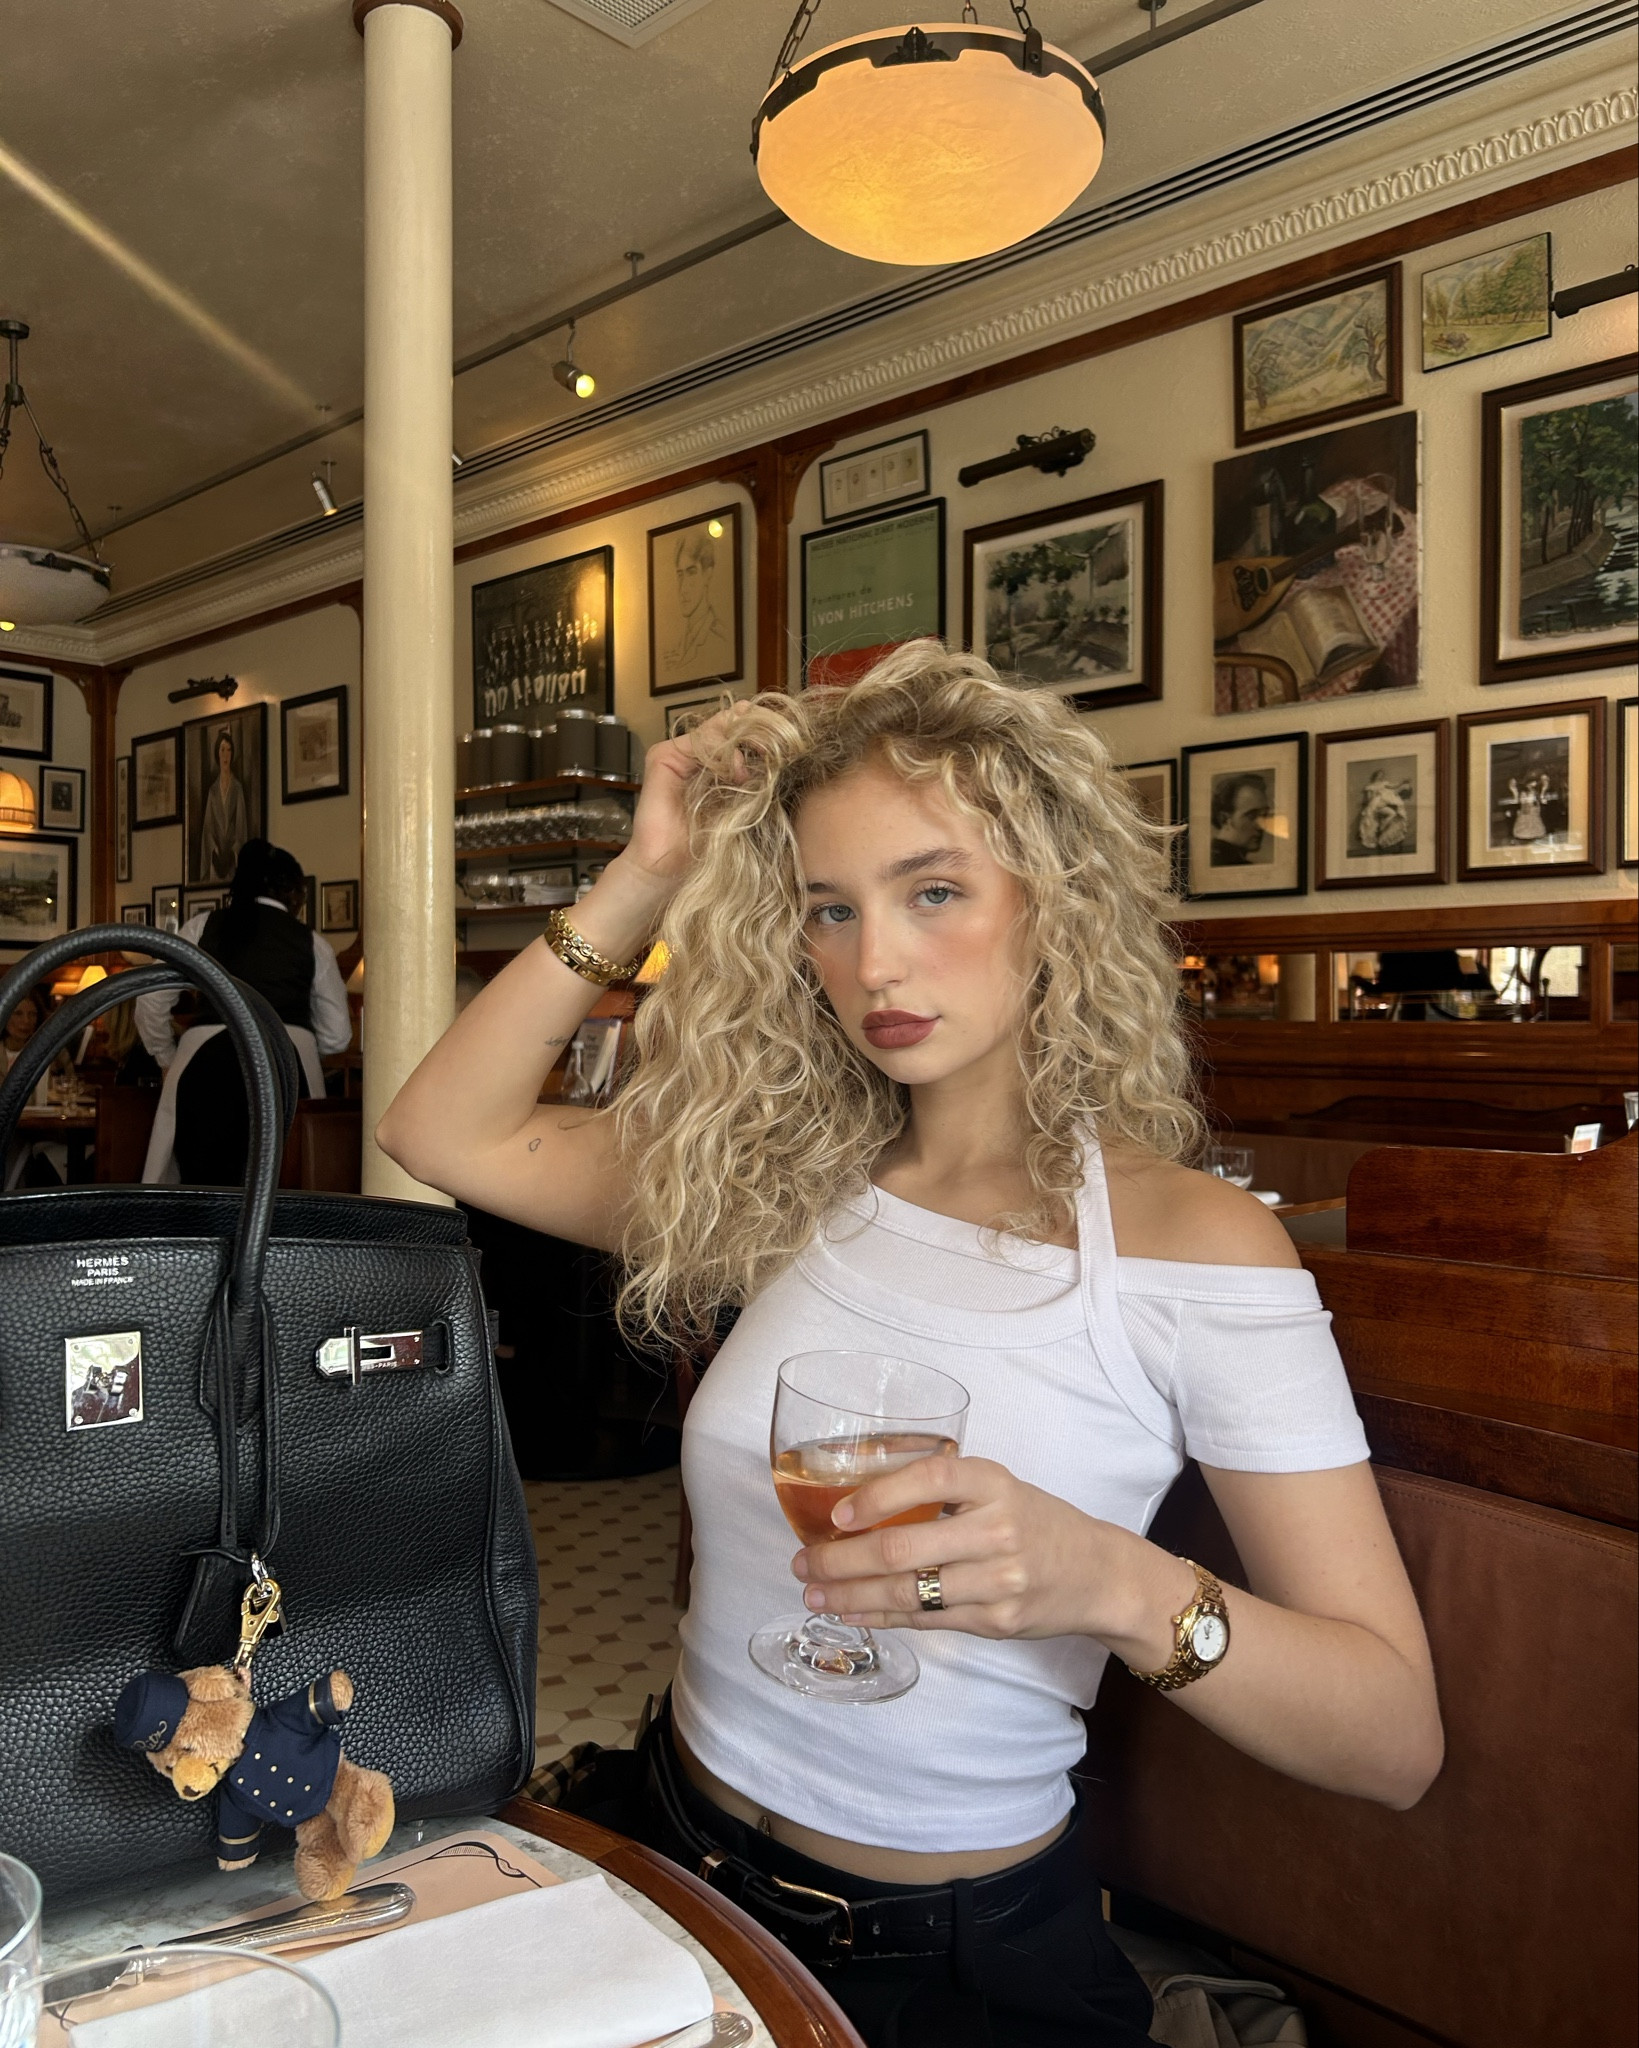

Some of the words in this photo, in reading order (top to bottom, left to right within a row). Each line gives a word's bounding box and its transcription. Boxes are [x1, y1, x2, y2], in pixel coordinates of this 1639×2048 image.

[896, 511, 936, 529] MODERNE
[860, 585, 872, 595] de
[87, 1267, 120, 1277] PARIS
[71, 1278, 94, 1286] MADE
[104, 1276, 134, 1285] FRANCE
